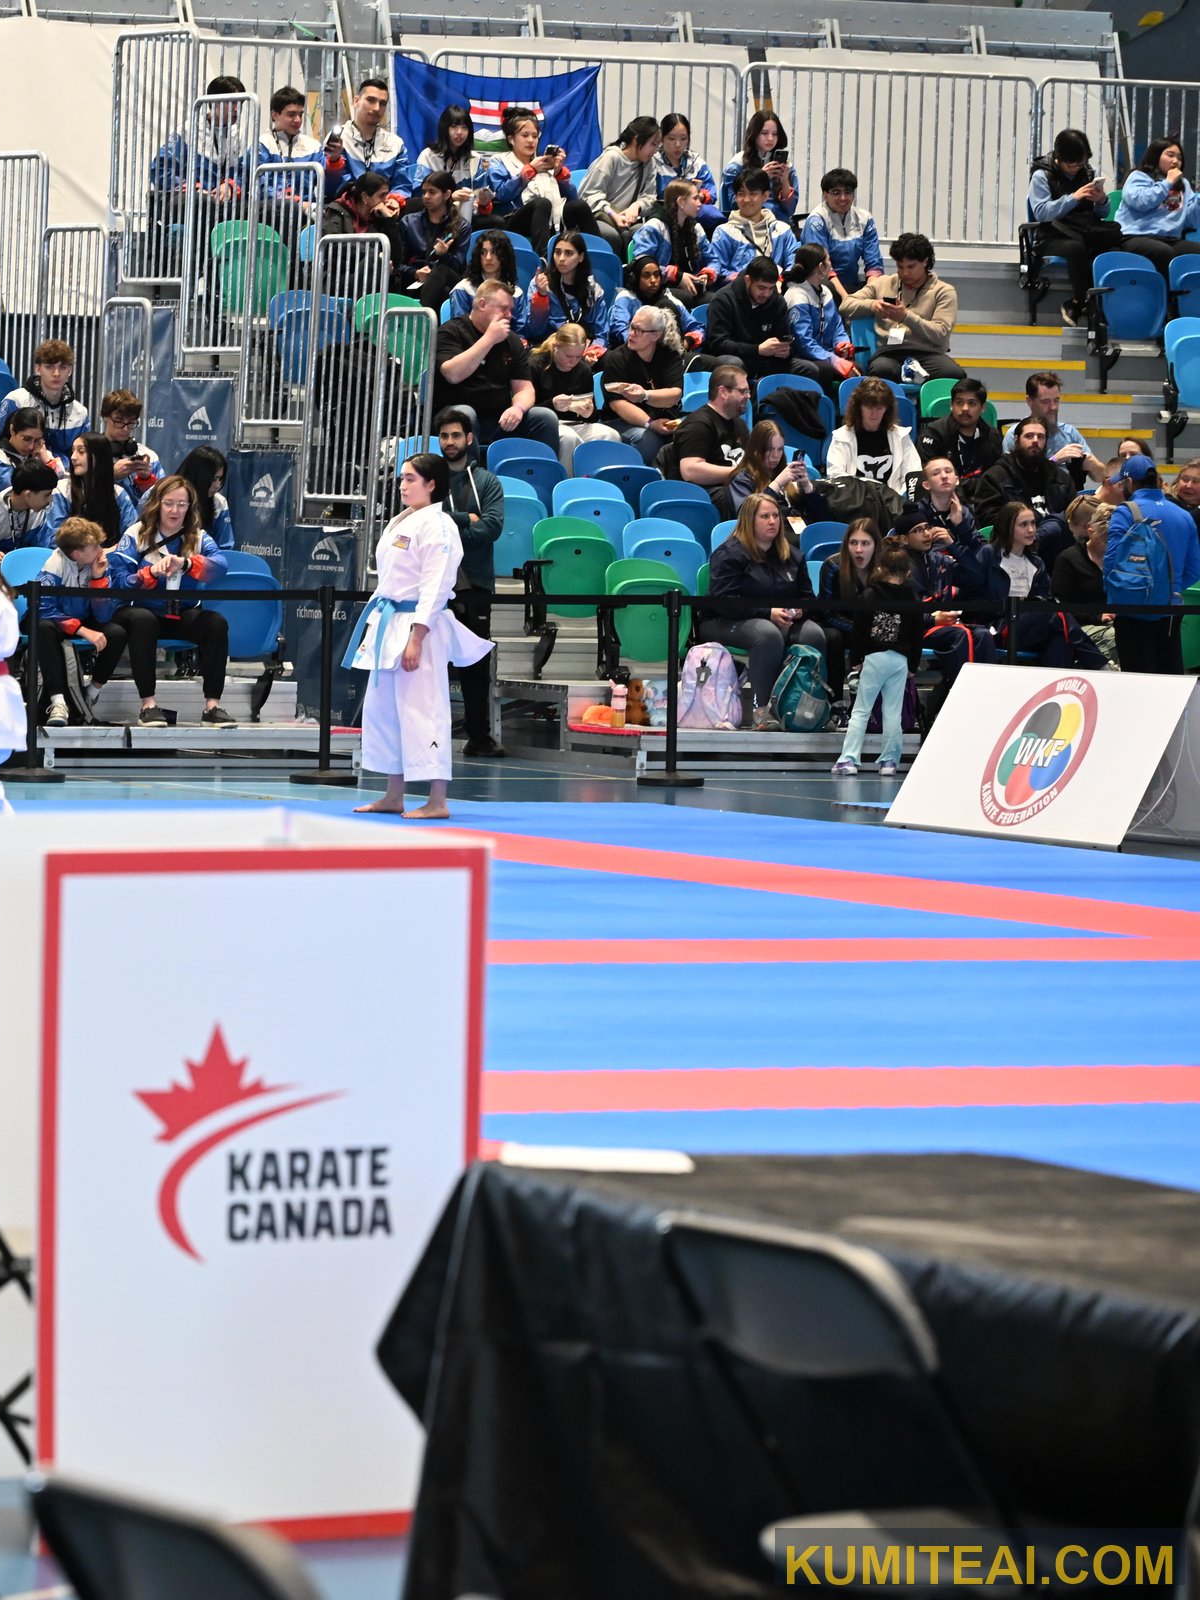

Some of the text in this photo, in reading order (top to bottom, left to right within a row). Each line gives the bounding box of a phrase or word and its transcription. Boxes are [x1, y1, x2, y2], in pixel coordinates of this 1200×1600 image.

[1056, 679, 1088, 695] WORLD
[1013, 737, 1066, 768] WKF
[982, 781, 1058, 825] KARATE FEDERATION
[227, 1147, 391, 1194] KARATE
[227, 1197, 392, 1242] CANADA
